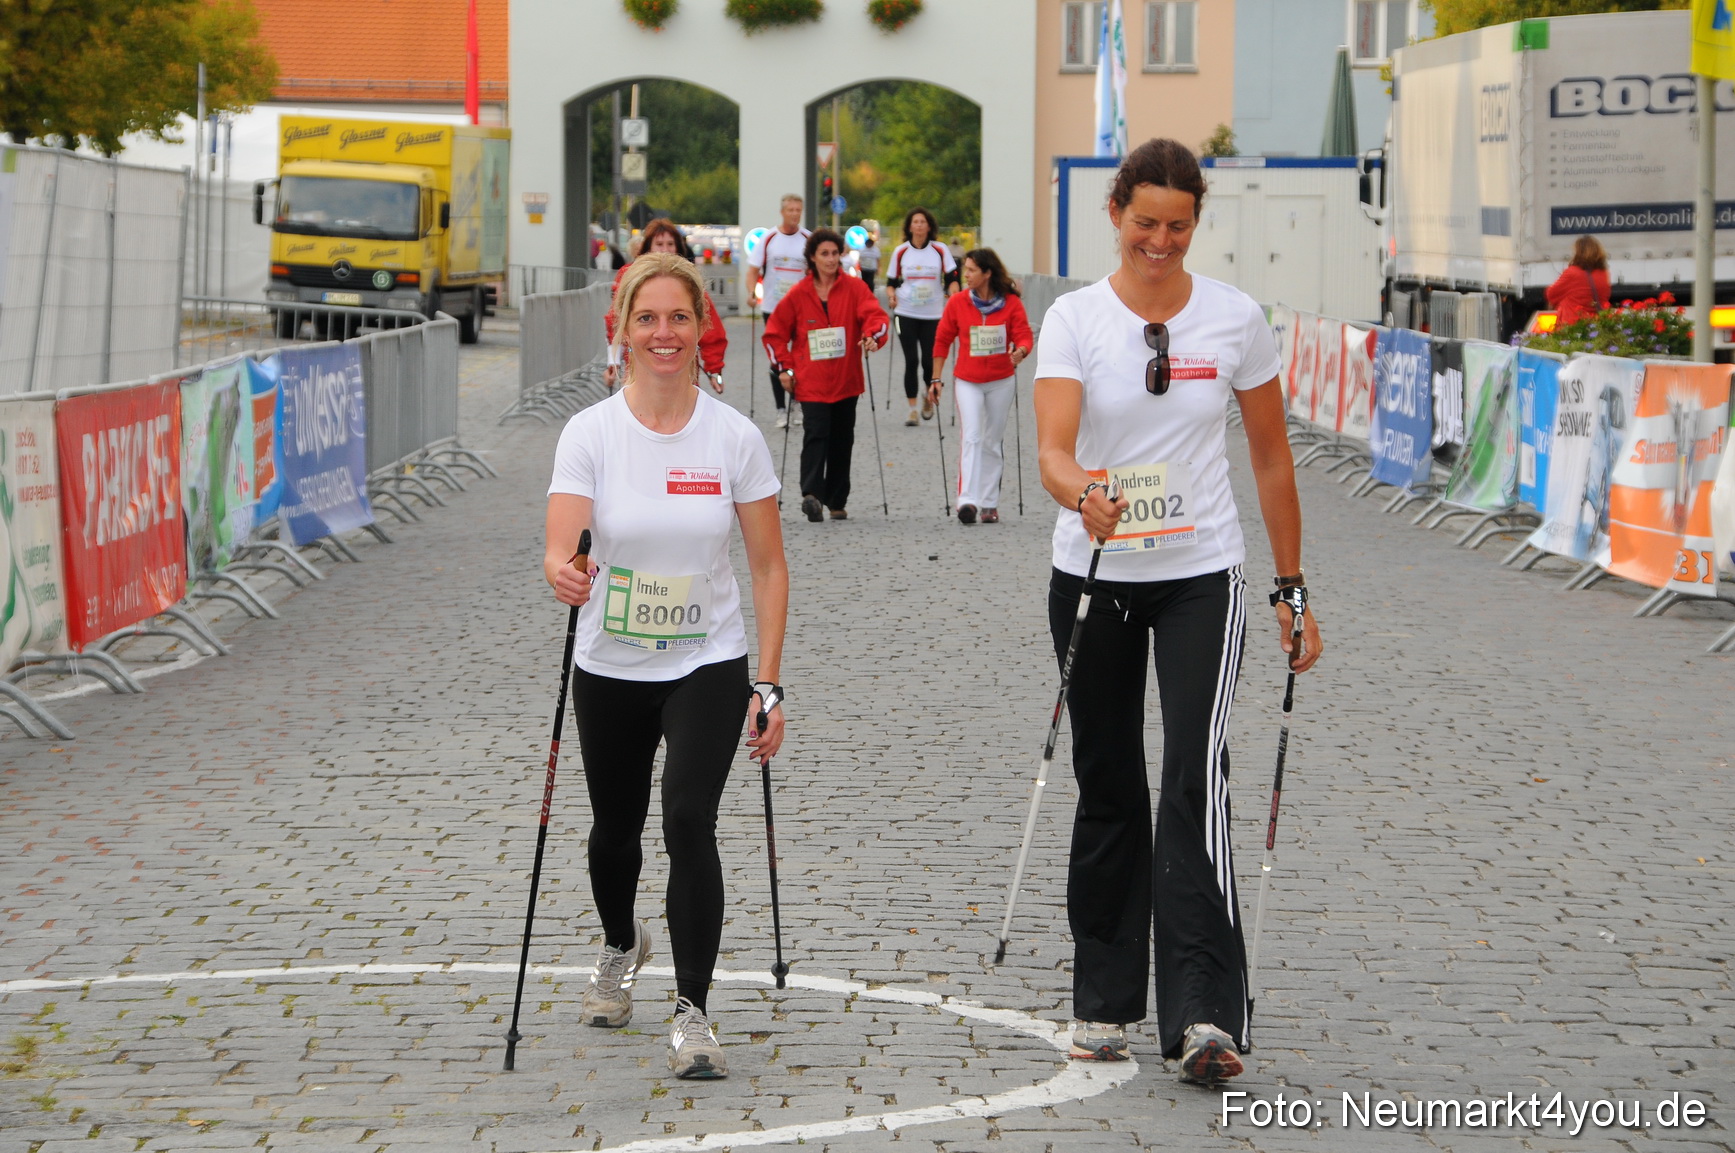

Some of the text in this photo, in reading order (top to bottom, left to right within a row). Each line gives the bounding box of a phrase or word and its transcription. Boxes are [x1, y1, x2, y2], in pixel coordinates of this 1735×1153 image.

[1563, 128, 1621, 138] Entwicklung
[819, 338, 843, 349] 8060
[980, 336, 1004, 346] 8080
[1182, 356, 1217, 366] Wildbad
[1170, 369, 1210, 378] Apotheke
[689, 472, 719, 480] Wildbad
[676, 483, 715, 493] Apotheke
[1155, 532, 1196, 543] PFLEIDERER
[636, 577, 668, 596] Imke
[635, 603, 702, 626] 8000
[668, 638, 707, 646] PFLEIDERER
